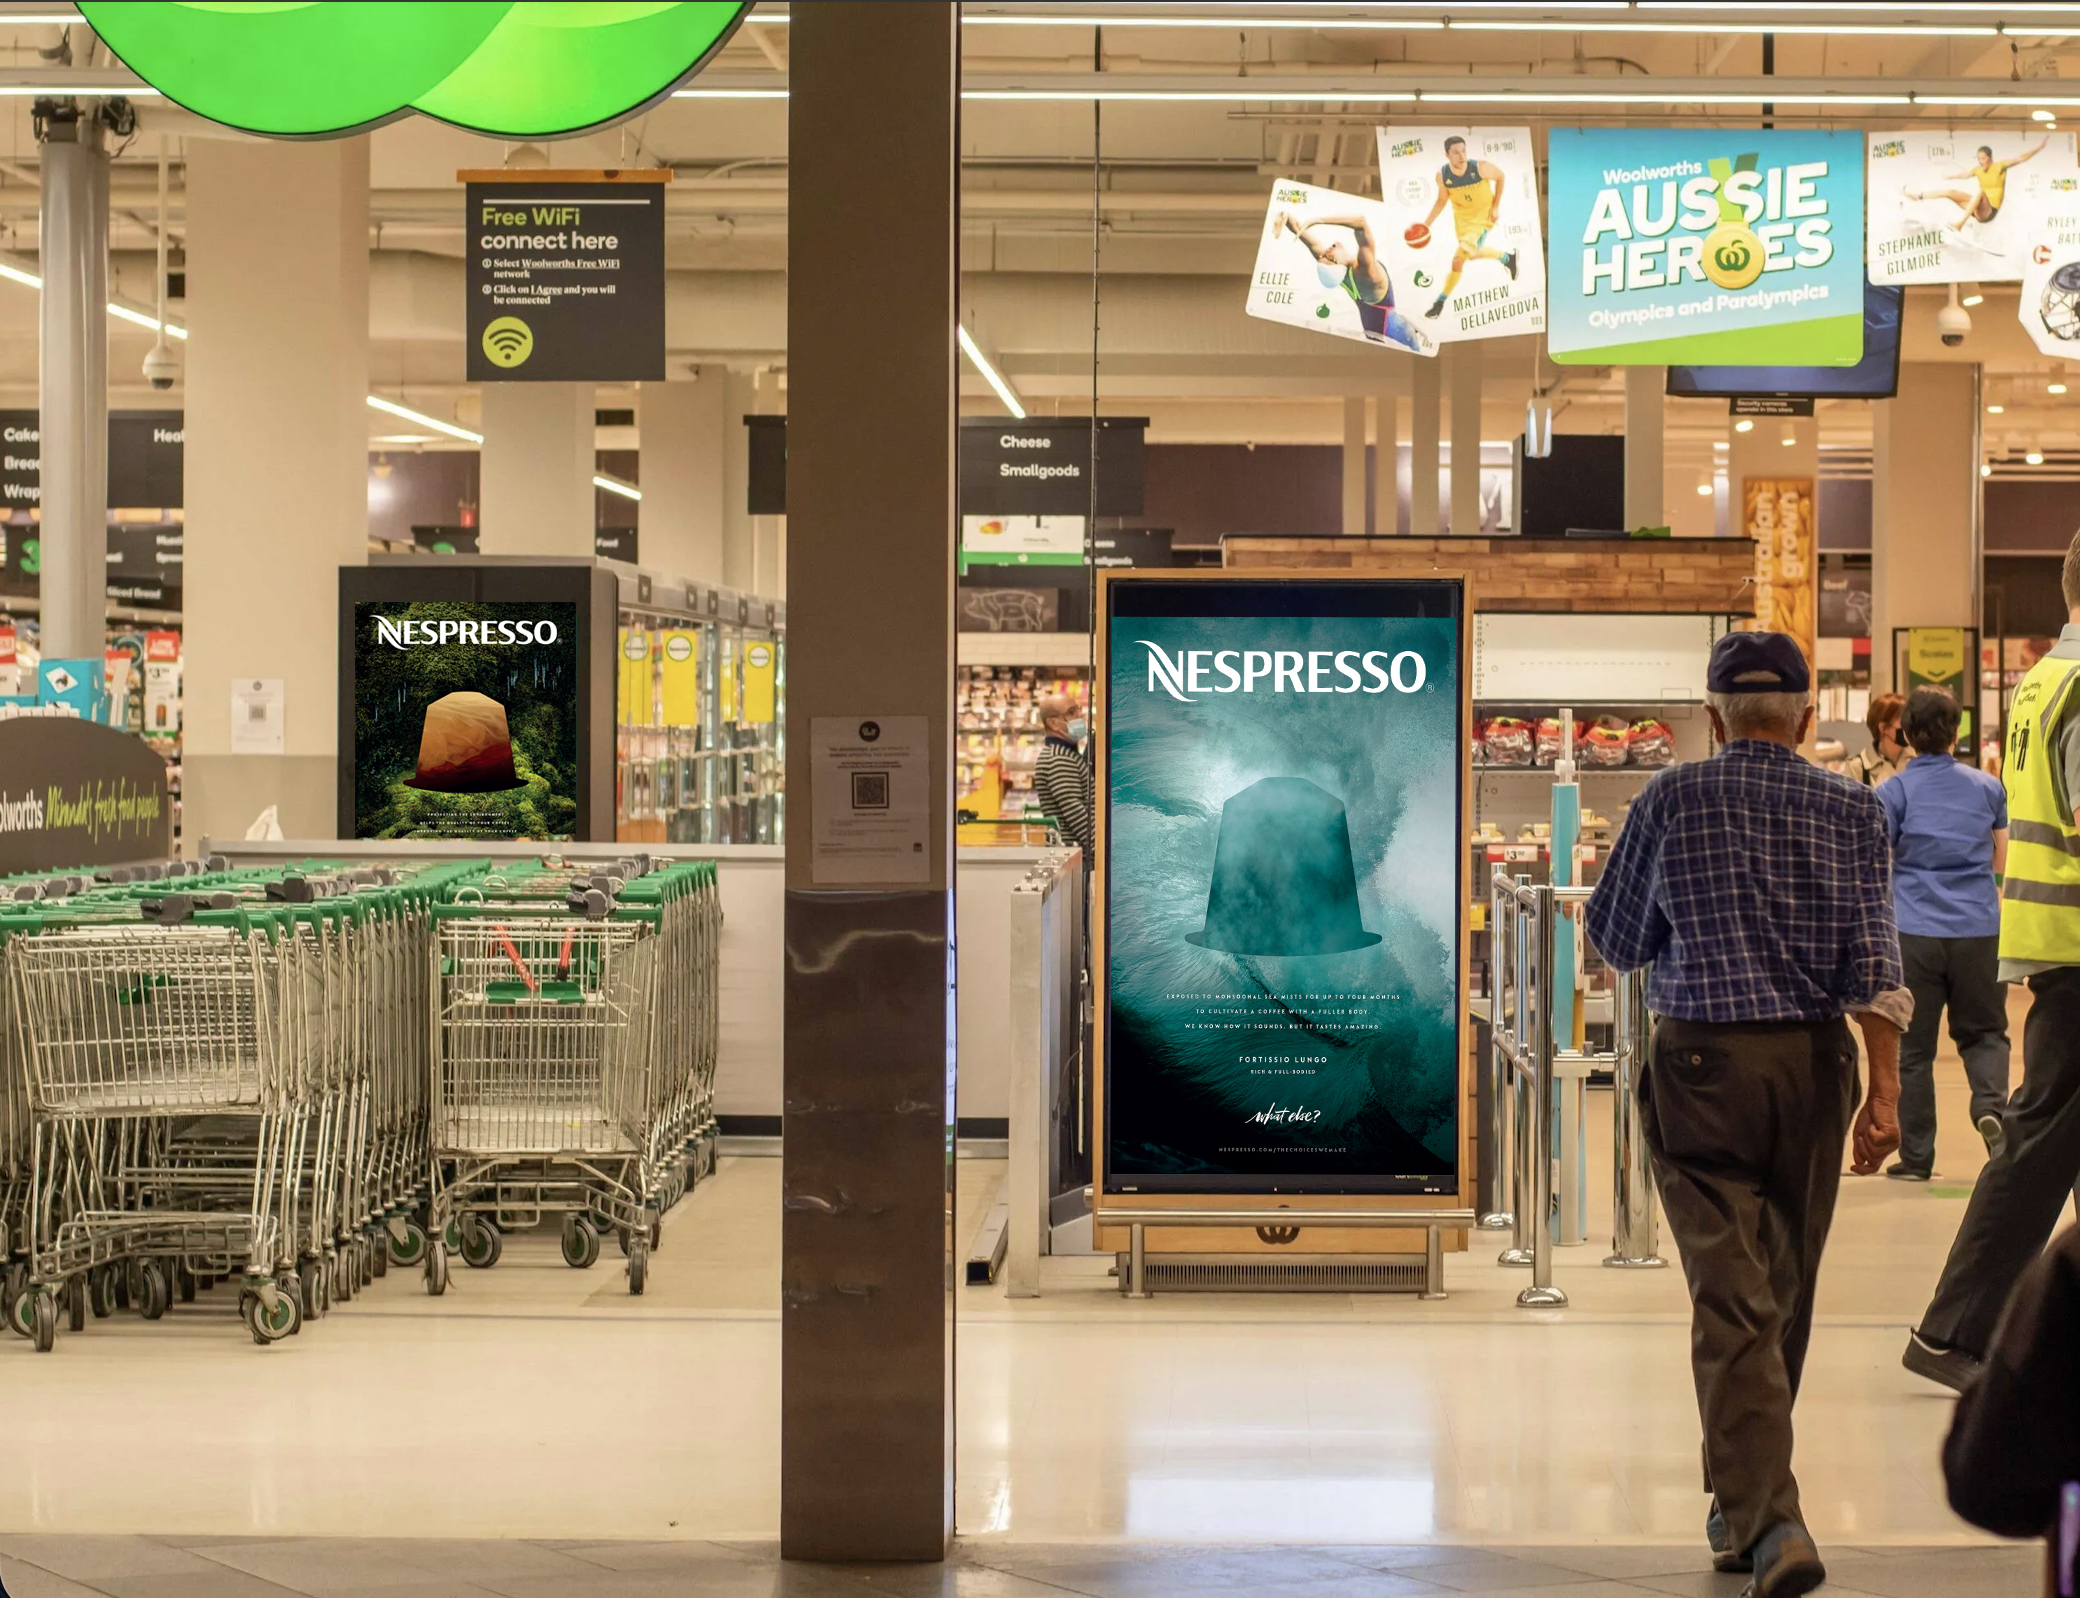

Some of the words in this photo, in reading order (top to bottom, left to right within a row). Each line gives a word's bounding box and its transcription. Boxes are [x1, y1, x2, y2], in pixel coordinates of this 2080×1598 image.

[1603, 160, 1702, 186] Woolworths
[1582, 162, 1829, 245] AUSSIE
[482, 207, 527, 226] Free
[532, 207, 581, 226] WiFi
[2048, 216, 2077, 228] RYLEY
[481, 232, 567, 250] connect
[572, 230, 619, 250] here
[1878, 230, 1944, 257] STEPHANIE
[494, 258, 520, 268] Select
[522, 258, 576, 269] Woolworths
[577, 258, 596, 269] Free
[598, 258, 620, 269] WiFi
[1887, 251, 1942, 276] GILMORE
[494, 270, 530, 278] network
[1260, 272, 1290, 286] ELLIE
[494, 284, 516, 294] Click
[536, 284, 562, 296] Agree
[564, 284, 580, 294] and
[582, 287, 598, 296] you
[600, 284, 616, 294] will
[494, 296, 504, 304] be
[506, 296, 550, 304] connected
[1266, 290, 1294, 304] COLE
[1454, 284, 1508, 312] MATTHEW
[1461, 297, 1539, 331] DELLAVEDOVA
[1588, 302, 1674, 330] Olympics
[1678, 296, 1714, 318] and
[1717, 283, 1829, 312] Paralympics
[1000, 435, 1051, 449] Cheese
[1000, 463, 1080, 480] Smallgoods
[370, 614, 559, 651] NESPRESSO
[1133, 640, 1427, 703] NESPRESSO
[1245, 1102, 1290, 1125] what
[1288, 1105, 1321, 1123] else?
